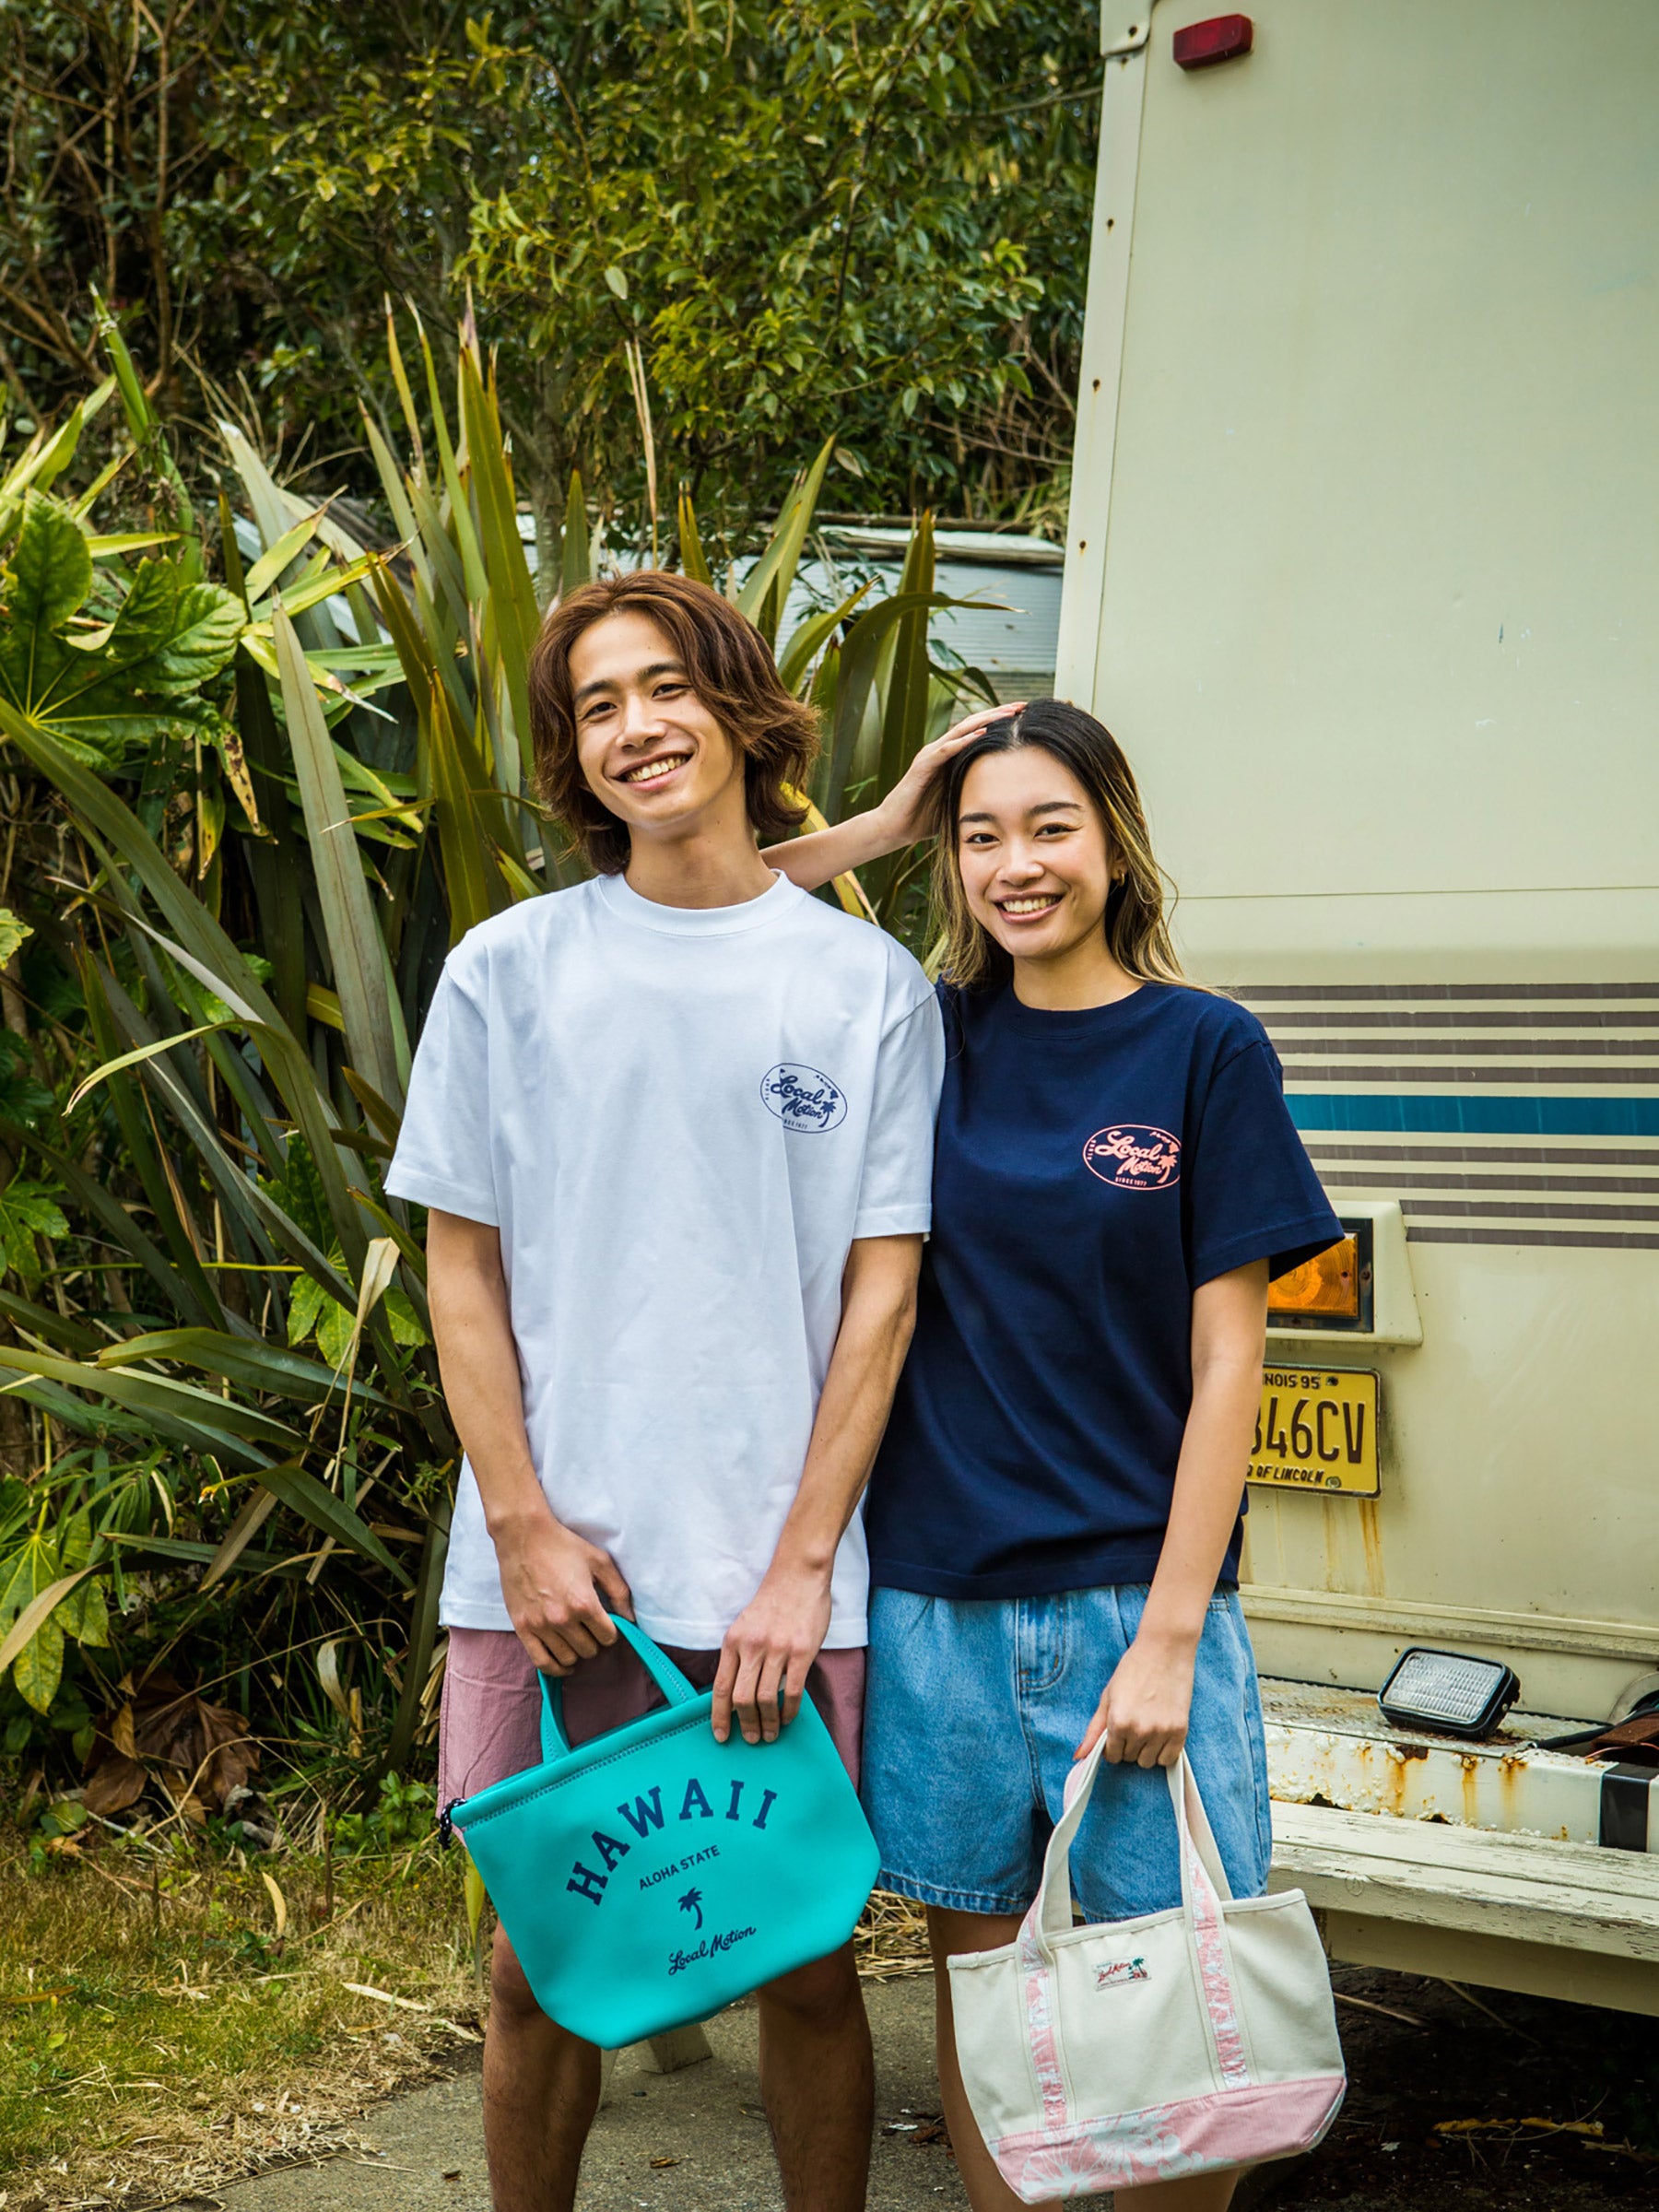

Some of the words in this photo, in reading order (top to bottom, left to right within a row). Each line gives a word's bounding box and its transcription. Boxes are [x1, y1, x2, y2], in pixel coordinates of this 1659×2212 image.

[771, 1068, 825, 1104] Local
[782, 1098, 823, 1119] Motion
[1095, 1130, 1163, 1160] Local
[1116, 1157, 1162, 1175] Motion
[1263, 1372, 1298, 1388] NOIS
[1300, 1376, 1321, 1389] 95
[1256, 1465, 1272, 1477] OF
[1273, 1467, 1324, 1483] LINCOLN
[566, 1778, 777, 1905] HAWAII
[639, 1865, 679, 1890] ALOHA
[680, 1845, 720, 1870] STATE
[668, 1941, 709, 1975] Local
[710, 1925, 756, 1958] Motion
